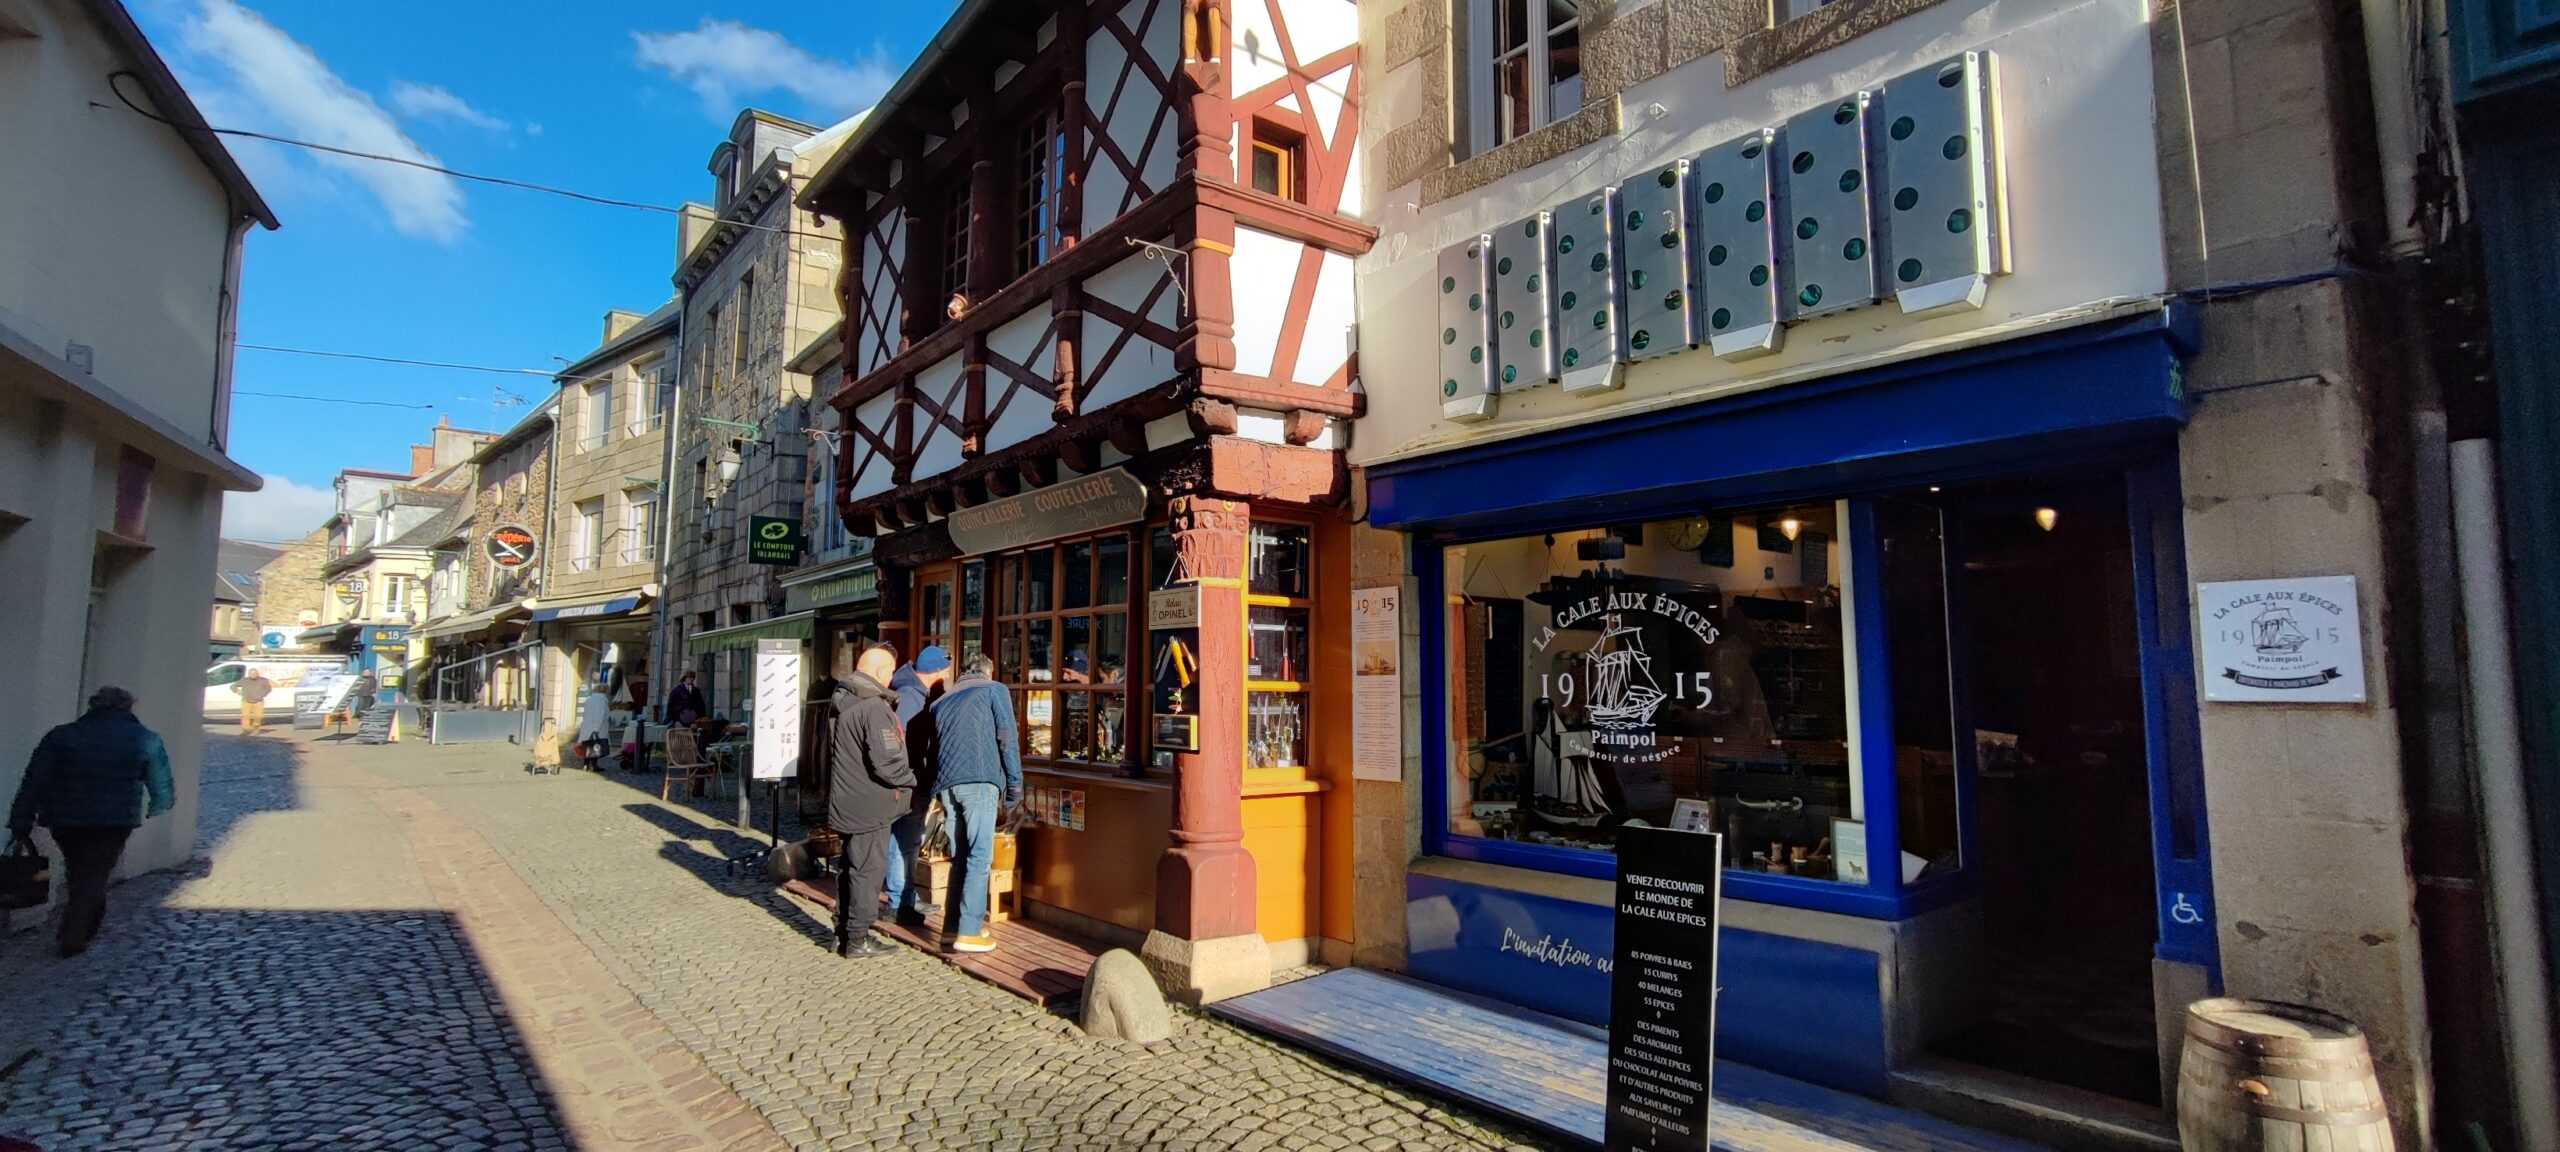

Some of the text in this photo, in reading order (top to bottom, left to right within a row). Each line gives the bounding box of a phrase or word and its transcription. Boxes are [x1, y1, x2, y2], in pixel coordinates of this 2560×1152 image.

[957, 501, 1025, 531] QUINCAILLERIE
[1034, 475, 1118, 512] COUTELLERIE
[753, 541, 795, 551] LE COMPTOIR
[757, 551, 791, 559] IRLANDAIS
[349, 581, 363, 593] 18
[820, 583, 827, 600] LE
[828, 577, 858, 598] COMPTOIR
[1158, 608, 1188, 620] OPINEL
[1356, 597, 1395, 615] 19 15
[2212, 591, 2343, 620] LA CALE AUX ÉPICES
[1532, 592, 1720, 652] LA CALE AUX ÉPICES
[387, 630, 399, 640] 18
[2220, 627, 2340, 645] 19 15
[2257, 655, 2303, 664] Paimpol
[1541, 671, 1713, 710] 19 15
[1591, 729, 1656, 749] Paimpol
[1568, 739, 1681, 764] Comptoir de négoce
[1626, 873, 1705, 895] VENEZ DECOUVRIR
[1635, 890, 1694, 909] LE MONDE DE
[1621, 903, 1707, 927] LA CALE AUX EPICES
[1501, 927, 1593, 967] L'invitation
[1630, 950, 1693, 970] 85 POIVRES & BAIES
[1643, 967, 1678, 982] 15 CURRYS
[1637, 980, 1683, 998] 40 MELANGES
[1643, 996, 1675, 1011] 55 EPICES
[1637, 1020, 1680, 1039] DES PIMENTS
[1633, 1034, 1683, 1054] DES AROMATES
[1624, 1046, 1691, 1072] DES SELS AUX EPICES
[1612, 1058, 1703, 1092] DU CHOCOLAT AUX POIVRES
[1619, 1074, 1694, 1105] ET D'AUTRES PRODUITS
[1629, 1092, 1683, 1117] AUX SAVEURS ET
[1620, 1104, 1690, 1136] PARFUMS D'AILLEURS
